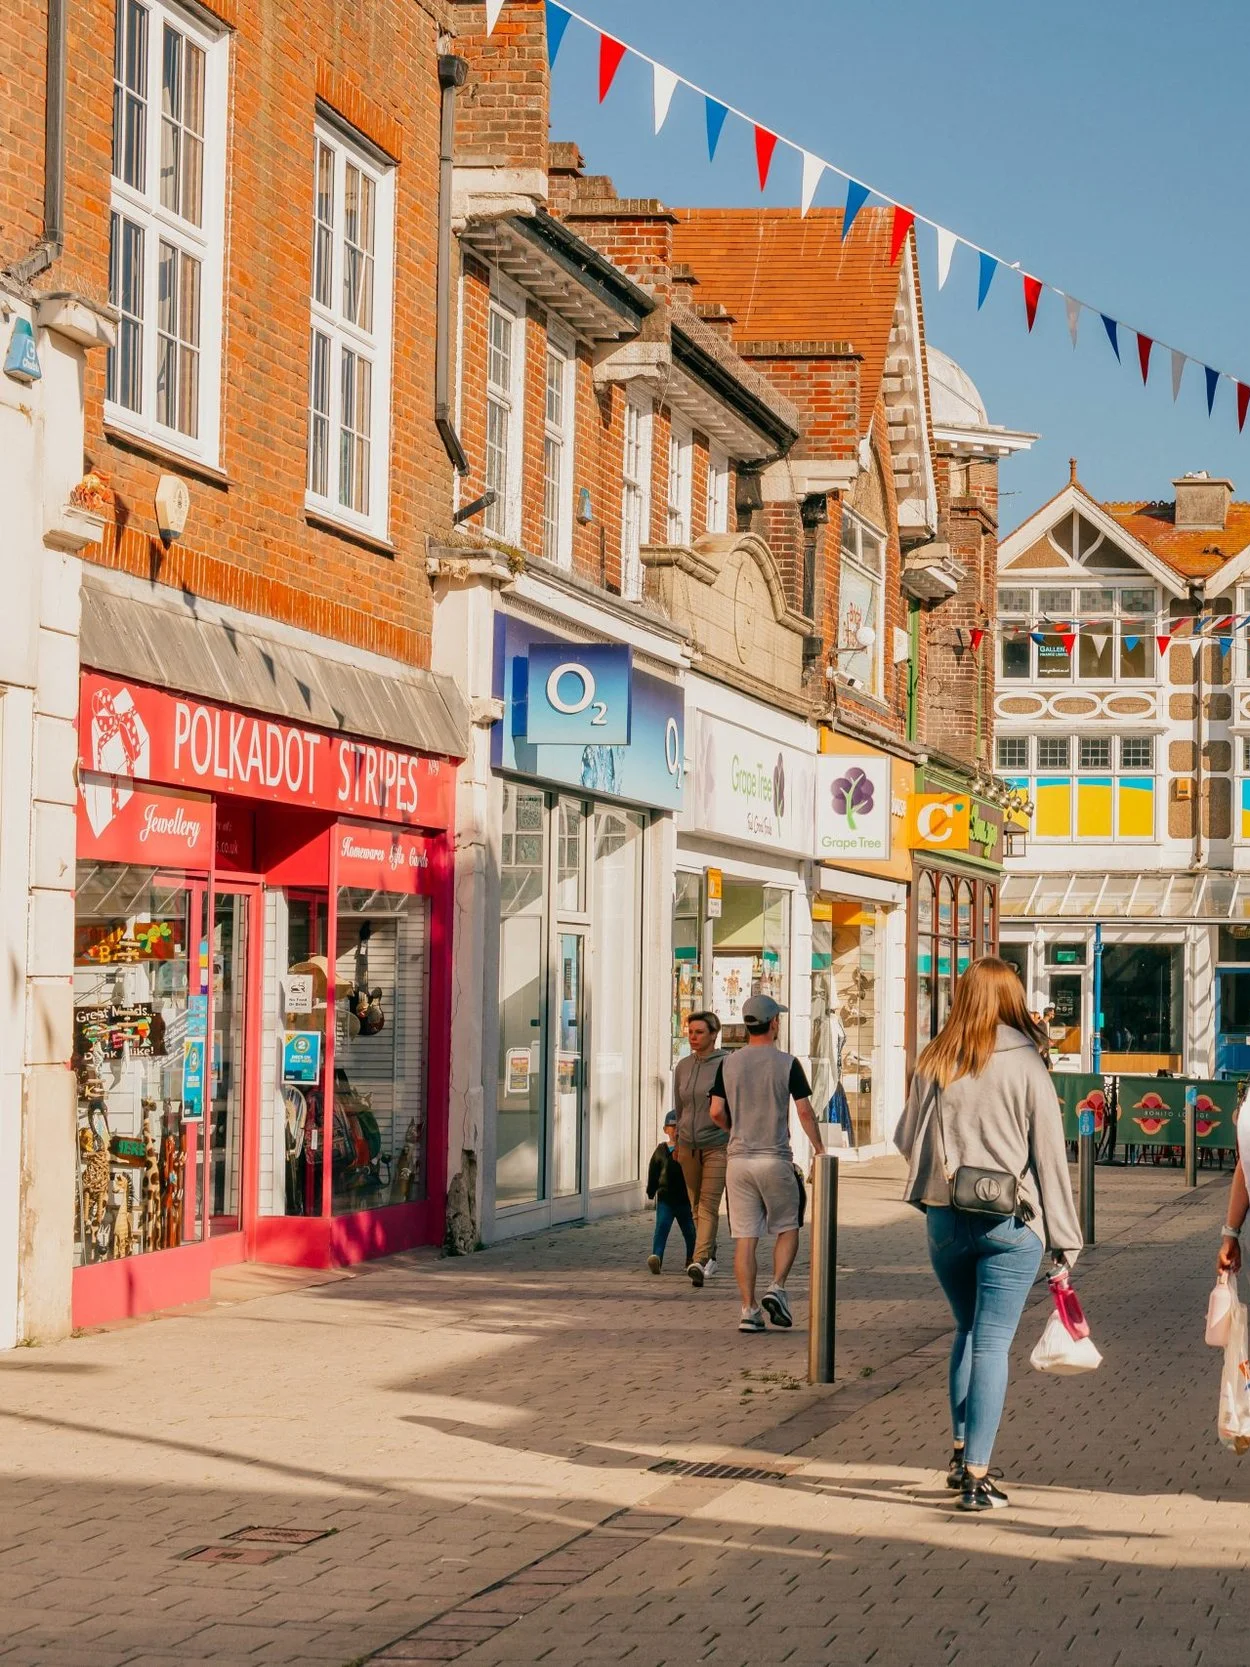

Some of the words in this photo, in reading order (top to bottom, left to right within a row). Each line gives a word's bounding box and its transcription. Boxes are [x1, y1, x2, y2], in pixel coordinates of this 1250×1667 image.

[174, 702, 321, 795] POLKADOT
[338, 740, 419, 814] STRIPES
[731, 753, 757, 806] Grape
[757, 762, 773, 803] Tree
[139, 803, 201, 849] Jewellery
[821, 834, 858, 851] Grape
[858, 836, 882, 849] Tree
[76, 1005, 110, 1023] Great
